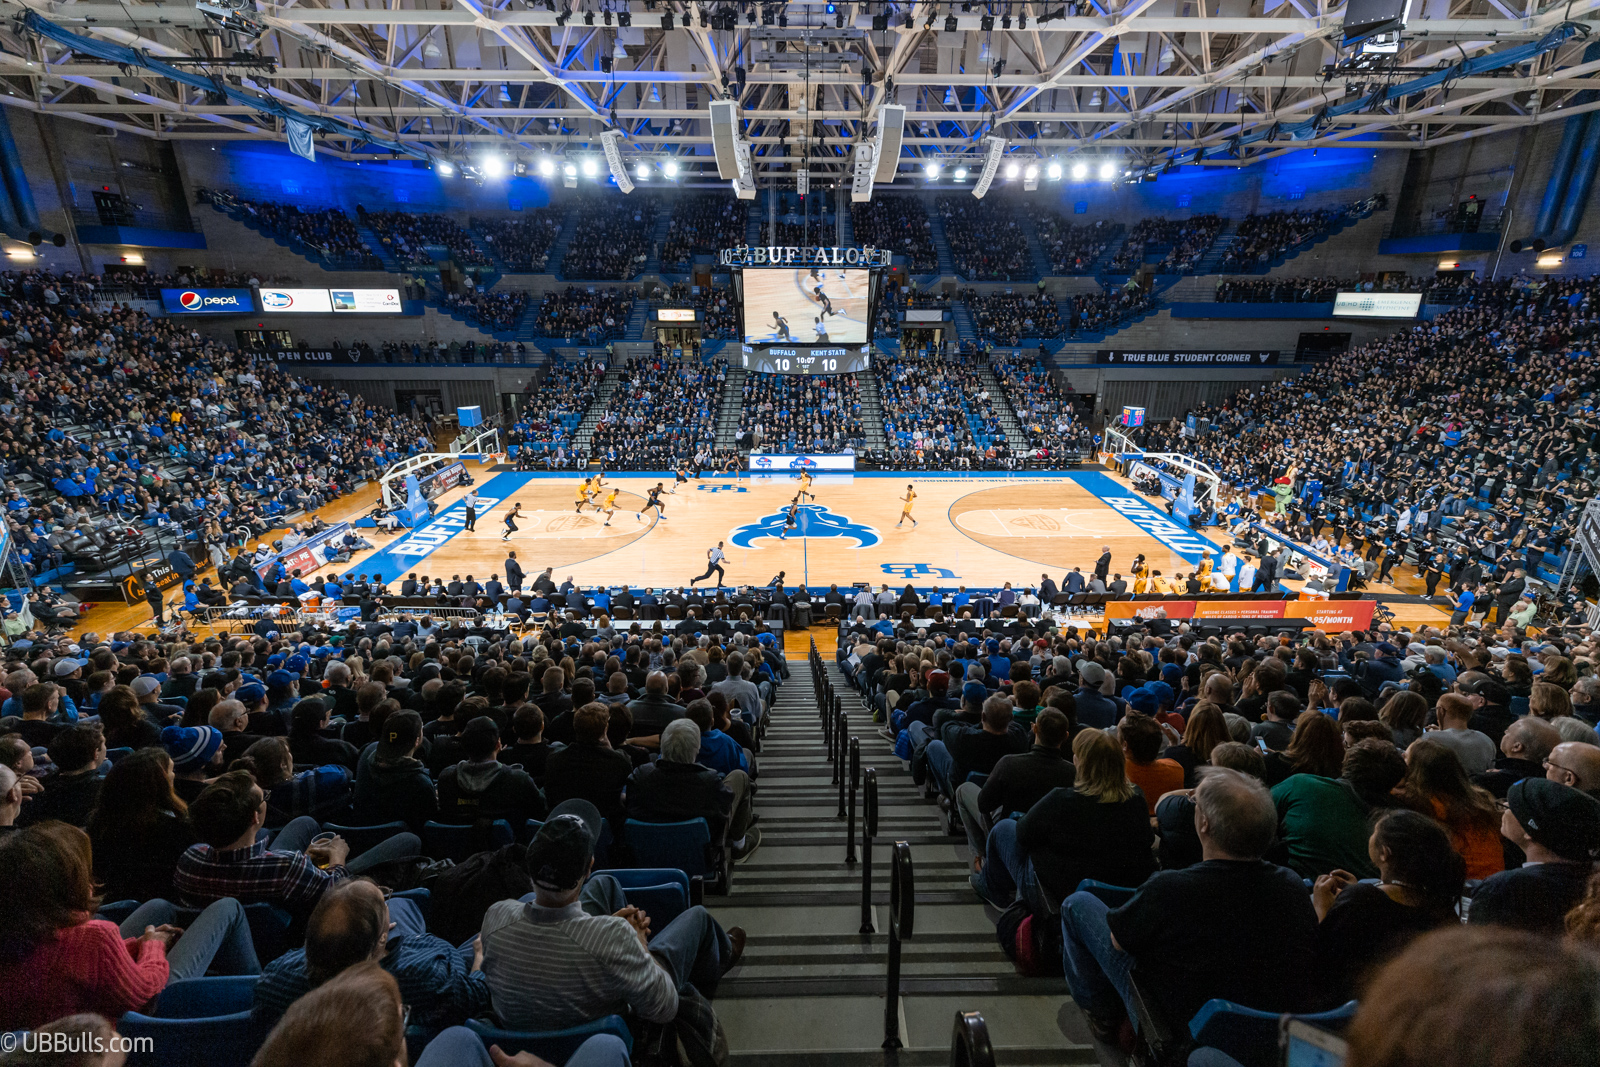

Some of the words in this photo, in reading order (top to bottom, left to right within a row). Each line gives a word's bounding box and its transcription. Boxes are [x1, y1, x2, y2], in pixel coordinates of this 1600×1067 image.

[754, 246, 860, 264] BUFFALO
[204, 296, 237, 306] pepsi
[278, 352, 300, 361] PEN
[304, 352, 332, 360] CLUB
[1122, 354, 1145, 362] TRUE
[1147, 354, 1170, 362] BLUE
[1174, 354, 1214, 362] STUDENT
[775, 358, 790, 371] 10
[822, 358, 837, 371] 10
[1100, 496, 1219, 554] BUFFALO
[300, 552, 310, 561] PIE
[152, 566, 170, 578] This
[156, 577, 171, 588] seat
[171, 572, 179, 580] in
[390, 732, 397, 742] P
